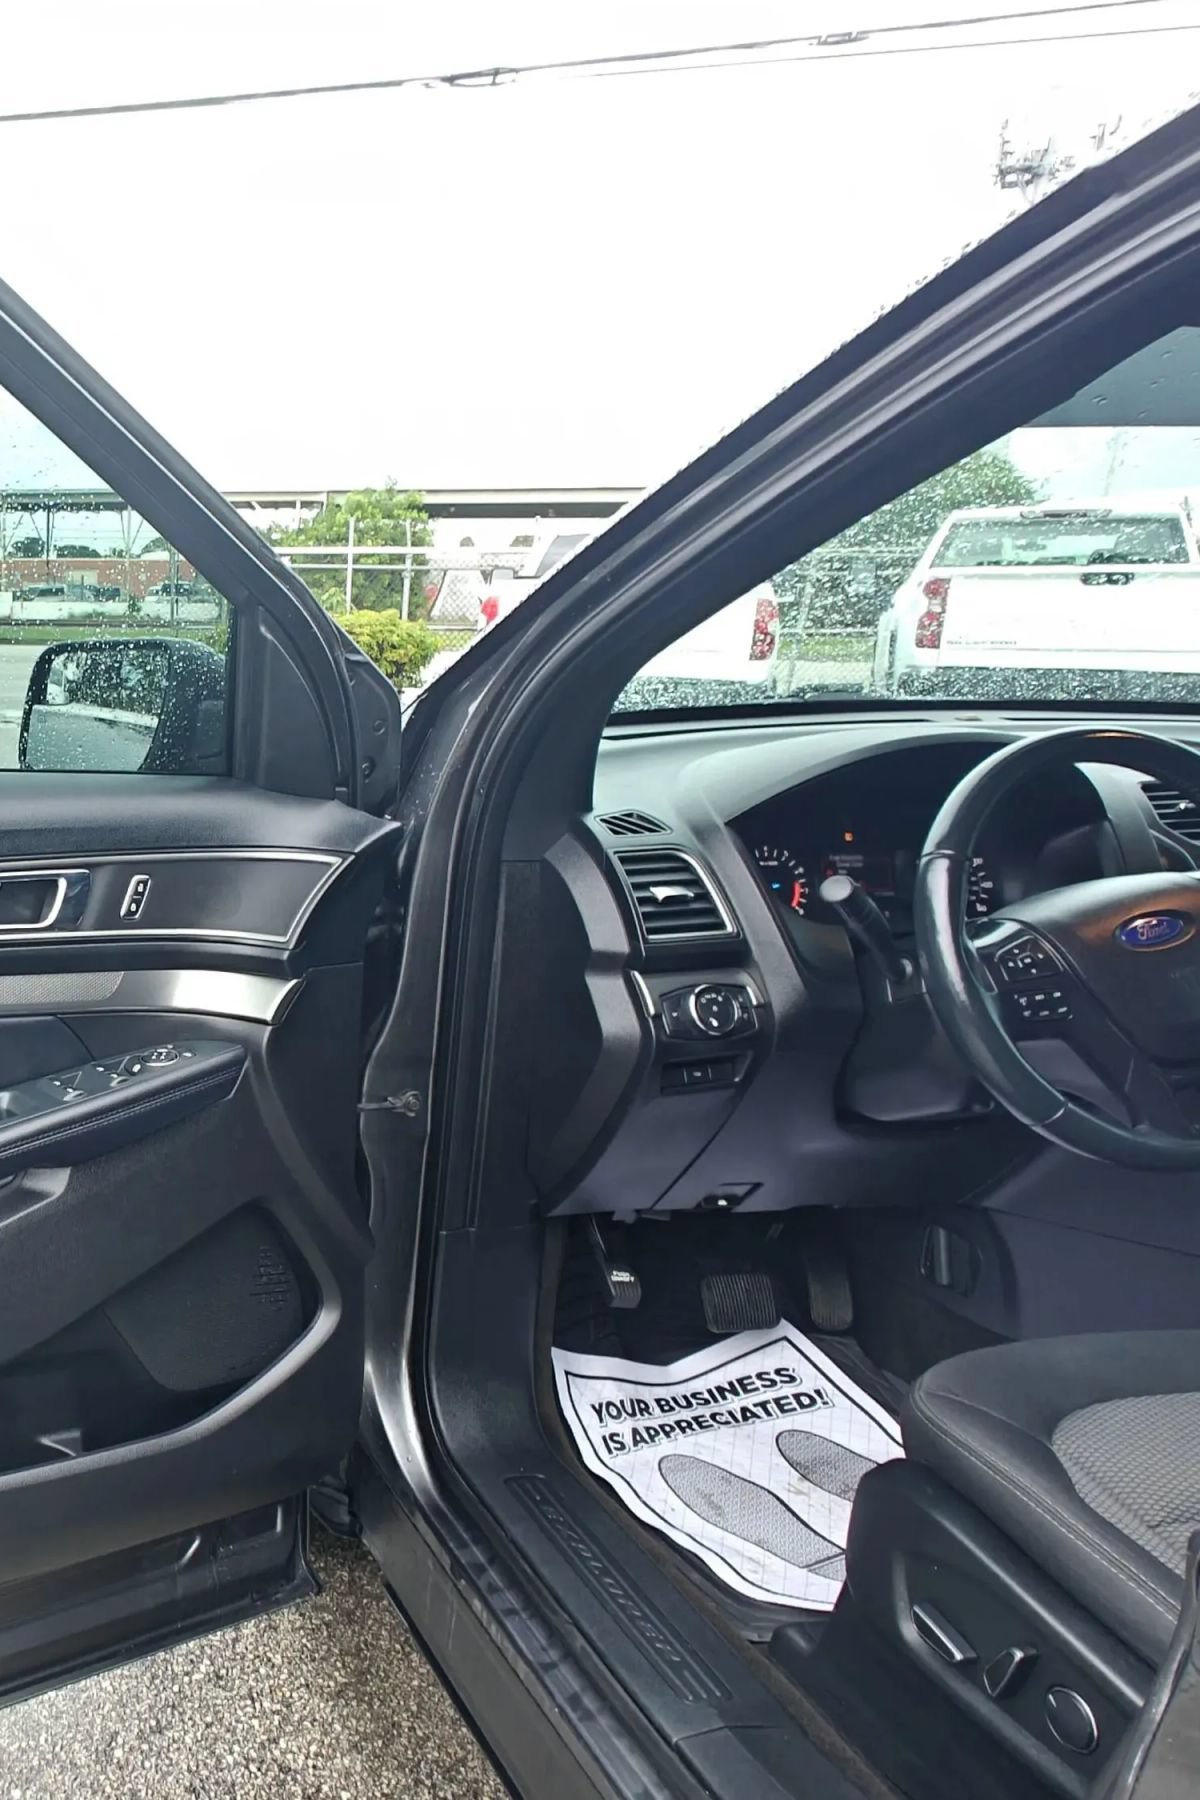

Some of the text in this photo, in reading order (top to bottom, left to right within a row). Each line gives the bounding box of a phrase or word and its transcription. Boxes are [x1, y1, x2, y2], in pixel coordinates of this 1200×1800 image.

[590, 1367, 799, 1425] YOUR BUSINESS
[602, 1388, 832, 1456] IS APPRECIATED!
